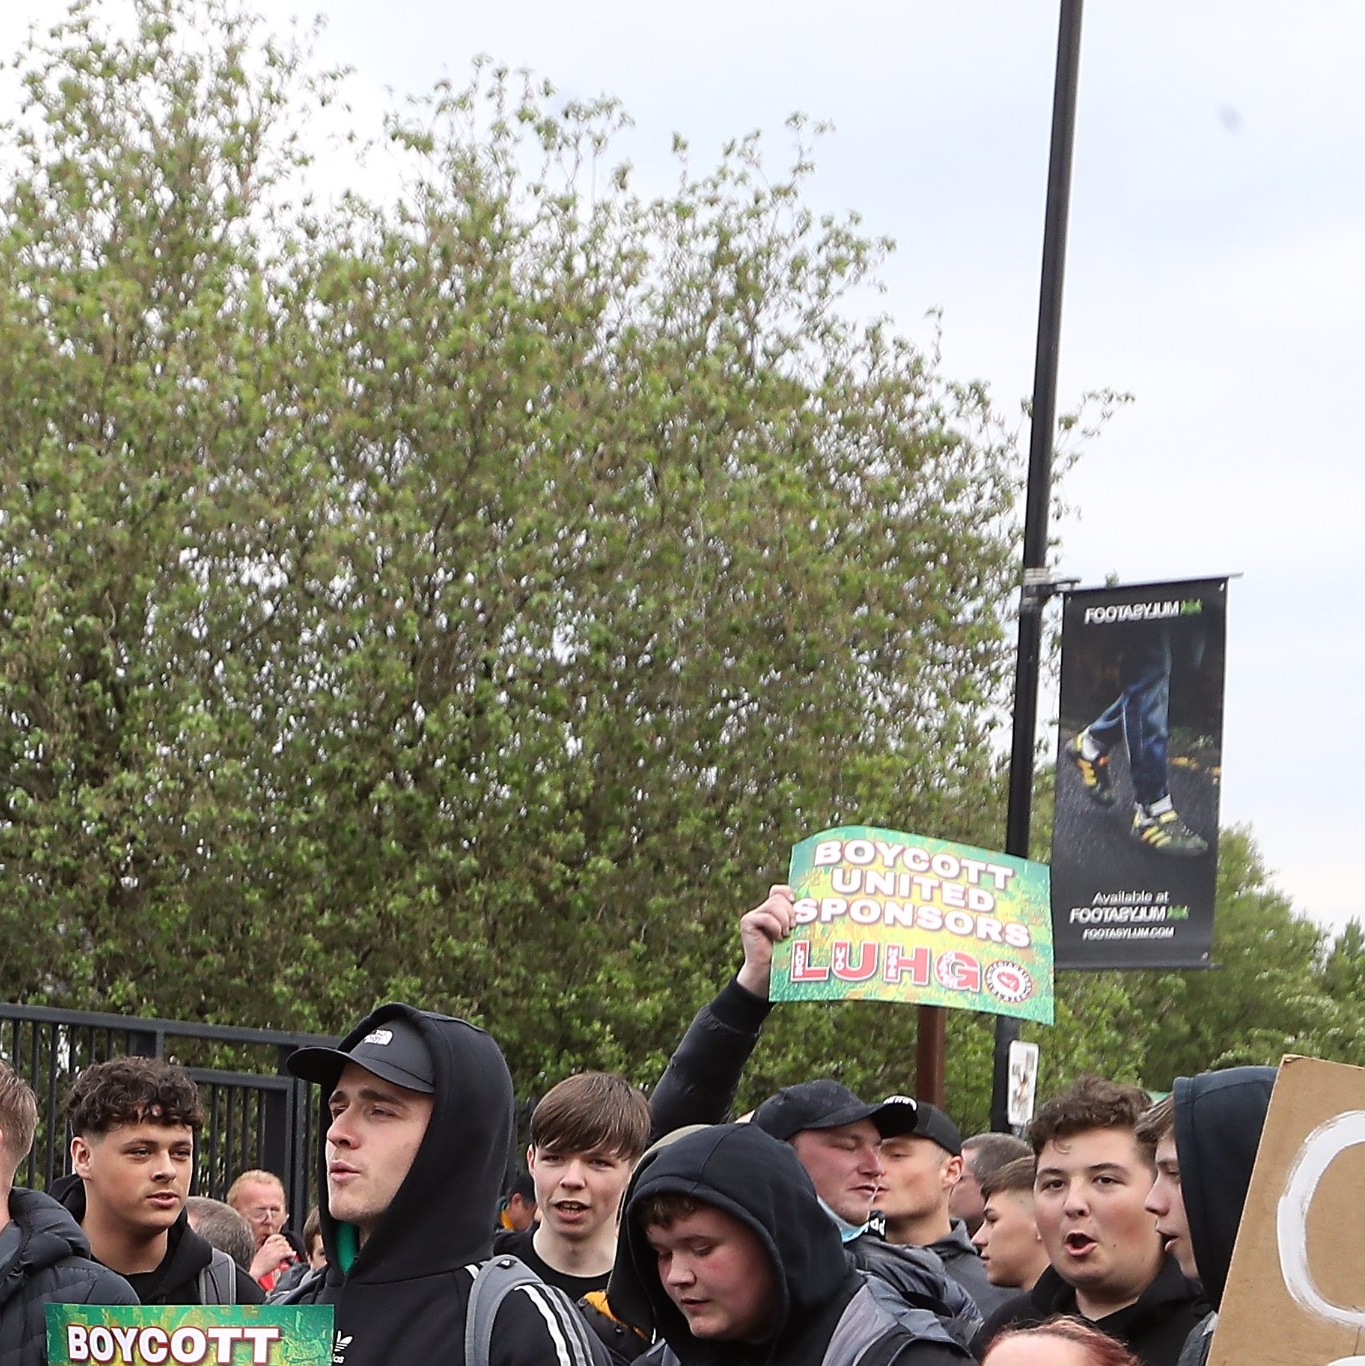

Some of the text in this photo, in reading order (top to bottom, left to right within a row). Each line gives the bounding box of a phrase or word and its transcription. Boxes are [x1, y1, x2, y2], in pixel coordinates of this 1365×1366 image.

[814, 839, 1015, 890] BOYCOTT
[831, 868, 996, 913] UNITED
[1092, 890, 1170, 905] Available at
[793, 897, 1032, 948] SPONSORS
[1082, 926, 1175, 940] FOOTASYLUM.COM
[790, 940, 982, 992] LUHG
[67, 1325, 280, 1365] BOYCOTT
